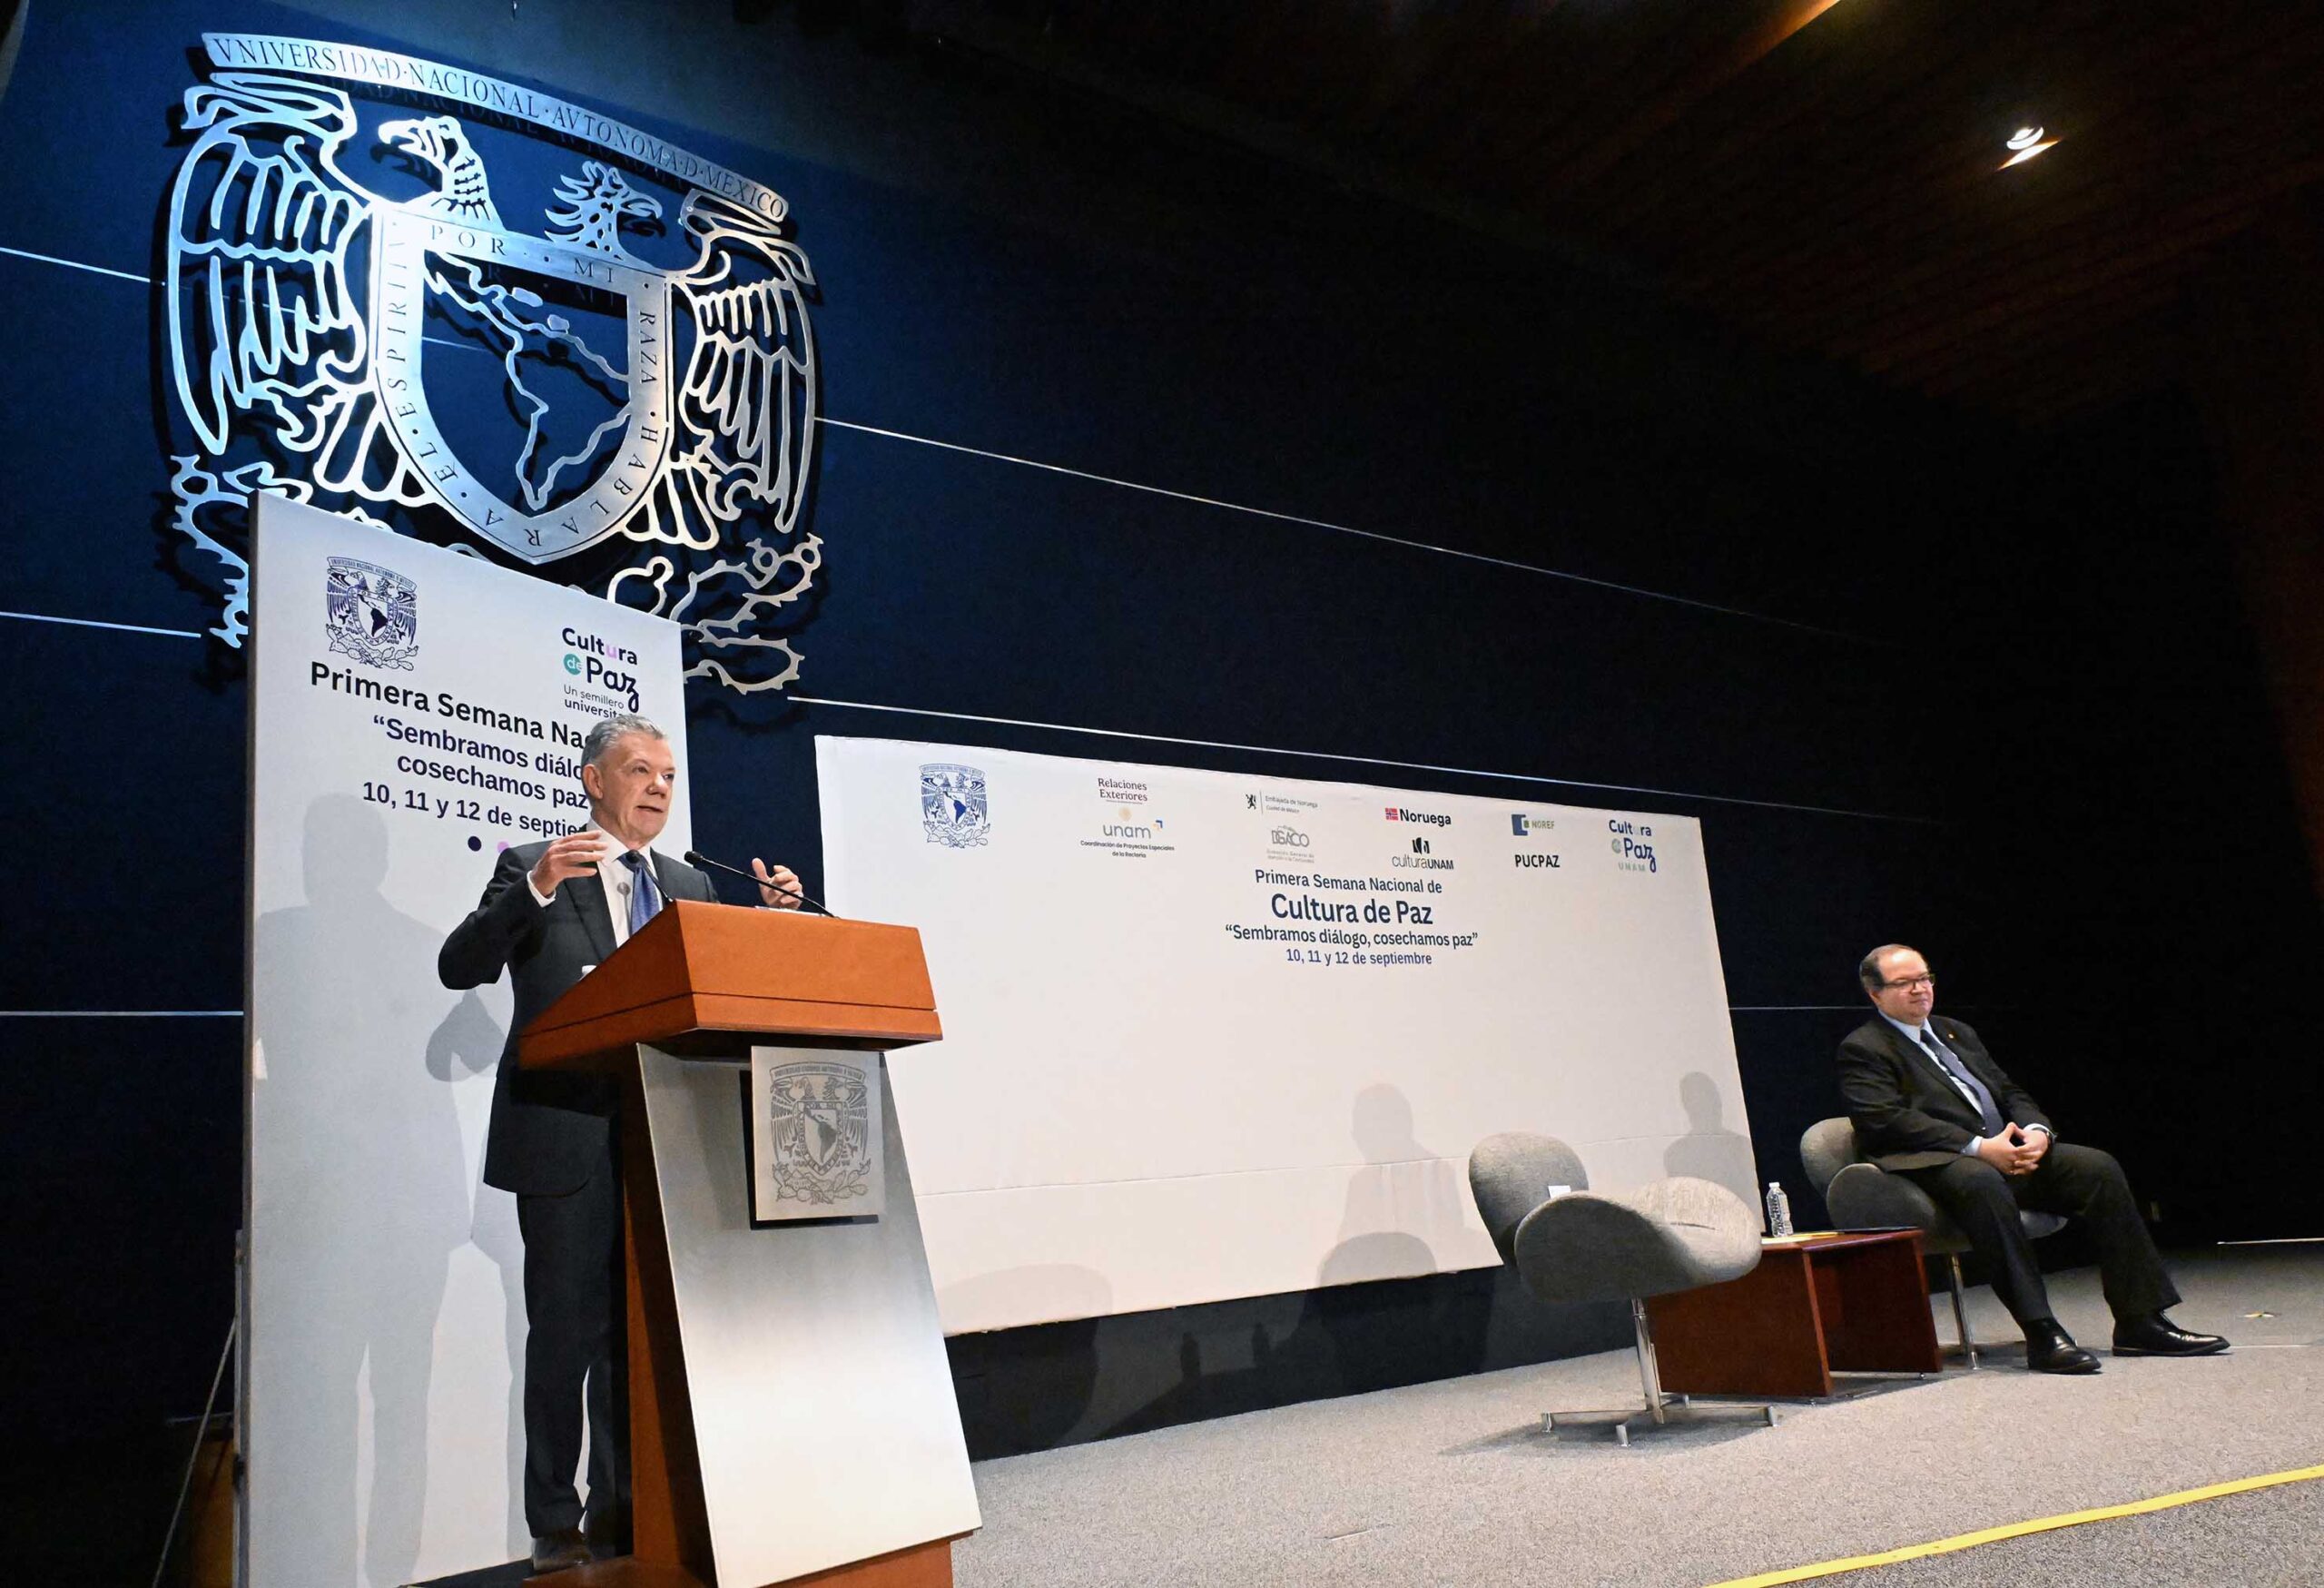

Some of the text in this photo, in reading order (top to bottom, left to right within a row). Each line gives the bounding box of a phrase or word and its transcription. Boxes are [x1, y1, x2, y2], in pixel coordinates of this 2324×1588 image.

[409, 62, 539, 120] NACIONAL
[704, 164, 786, 219] MEXICO
[430, 224, 507, 256] POR
[573, 258, 614, 283] MI
[639, 311, 658, 385] RAZA
[419, 442, 459, 482] EL
[562, 627, 638, 666] Cultura
[564, 684, 625, 709] Un semillero
[586, 656, 639, 714] Paz
[310, 661, 430, 713] Primera
[438, 693, 544, 740] Semana
[565, 699, 623, 718] universit
[373, 715, 528, 768] “Sembramos
[397, 755, 546, 800] cosechamos
[1098, 778, 1147, 791] Relaciones
[363, 781, 397, 809] 10,
[404, 789, 429, 812] 11
[437, 797, 448, 819] y
[456, 798, 480, 821] 12
[487, 805, 512, 826] de
[1099, 789, 1148, 802] Exteriores
[1103, 824, 1151, 839] unam
[1399, 808, 1452, 827] Noruega
[1531, 820, 1555, 830] NOREF
[1514, 854, 1561, 868] PUCPAZ
[1623, 837, 1657, 873] Paz
[1255, 869, 1442, 893] Primera Semana Nacional de
[1271, 893, 1433, 924] Cultura de Paz
[1226, 924, 1316, 943] “Sembramos
[1319, 928, 1371, 949] diálogo,
[1374, 931, 1450, 947] cosechamos
[1286, 949, 1433, 968] 10, 11 y 12 de septiembre
